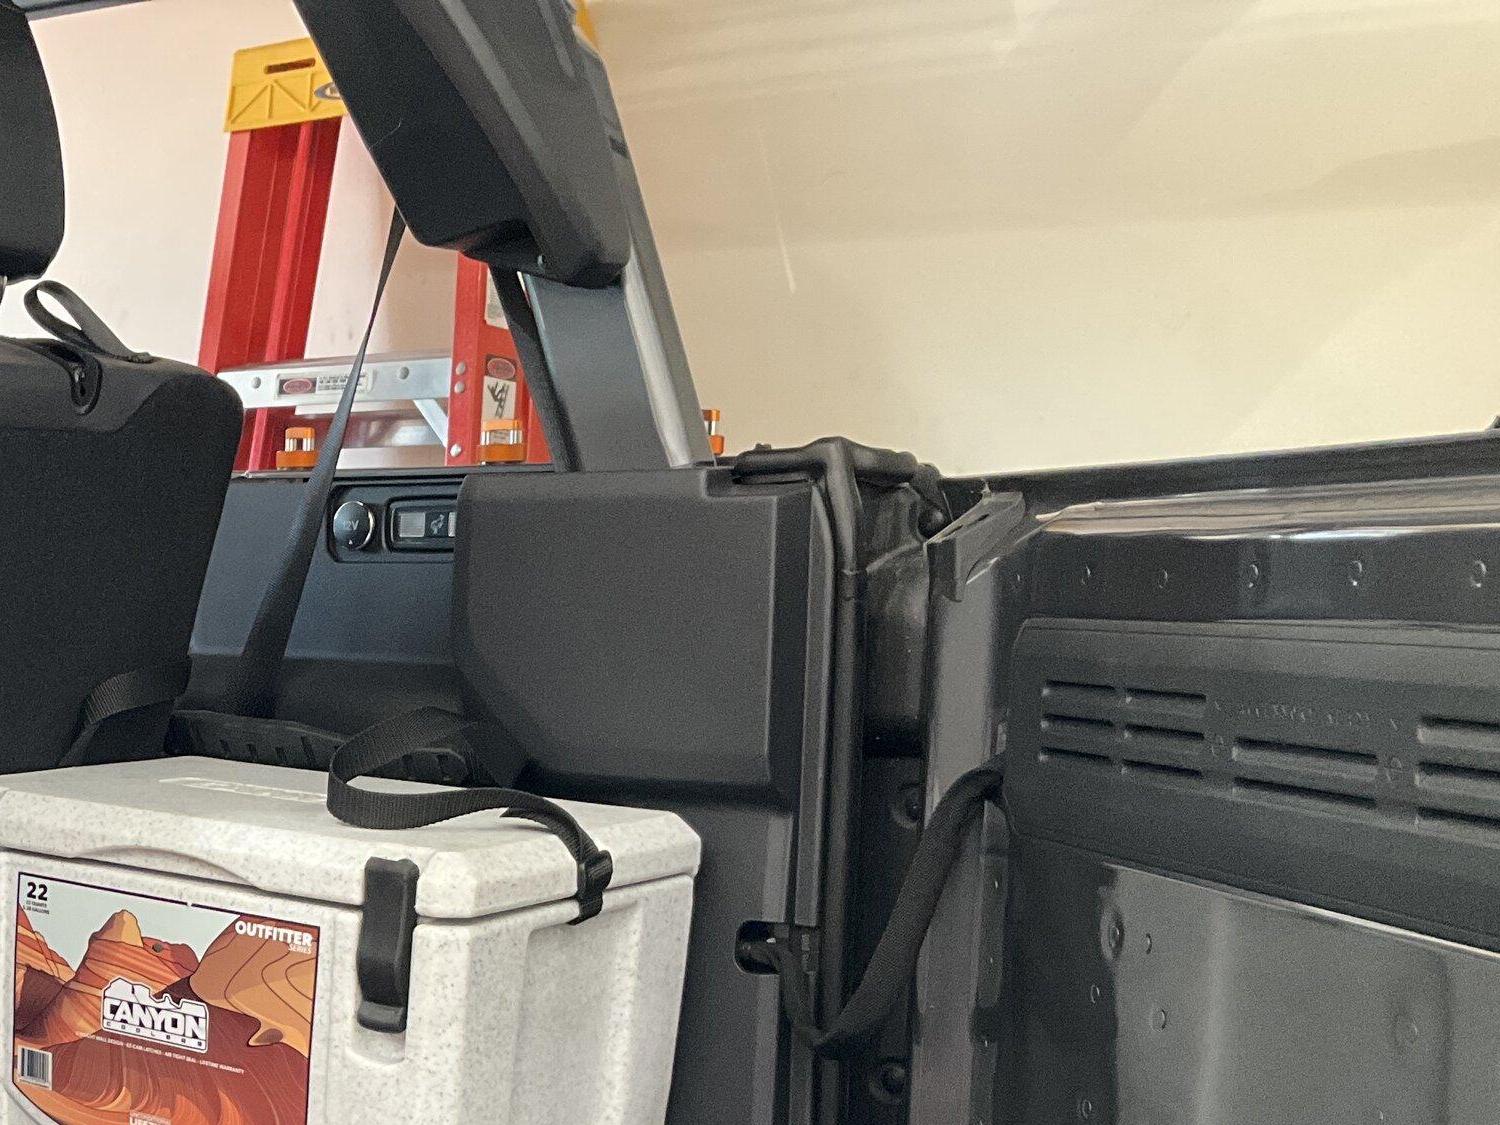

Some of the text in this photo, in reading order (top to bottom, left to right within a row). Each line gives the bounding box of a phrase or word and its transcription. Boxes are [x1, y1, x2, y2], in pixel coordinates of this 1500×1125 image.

[342, 519, 360, 531] 12V
[26, 881, 48, 901] 22
[234, 920, 313, 947] OUTFITTER
[288, 943, 312, 955] SERIES
[103, 997, 207, 1041] CANYON
